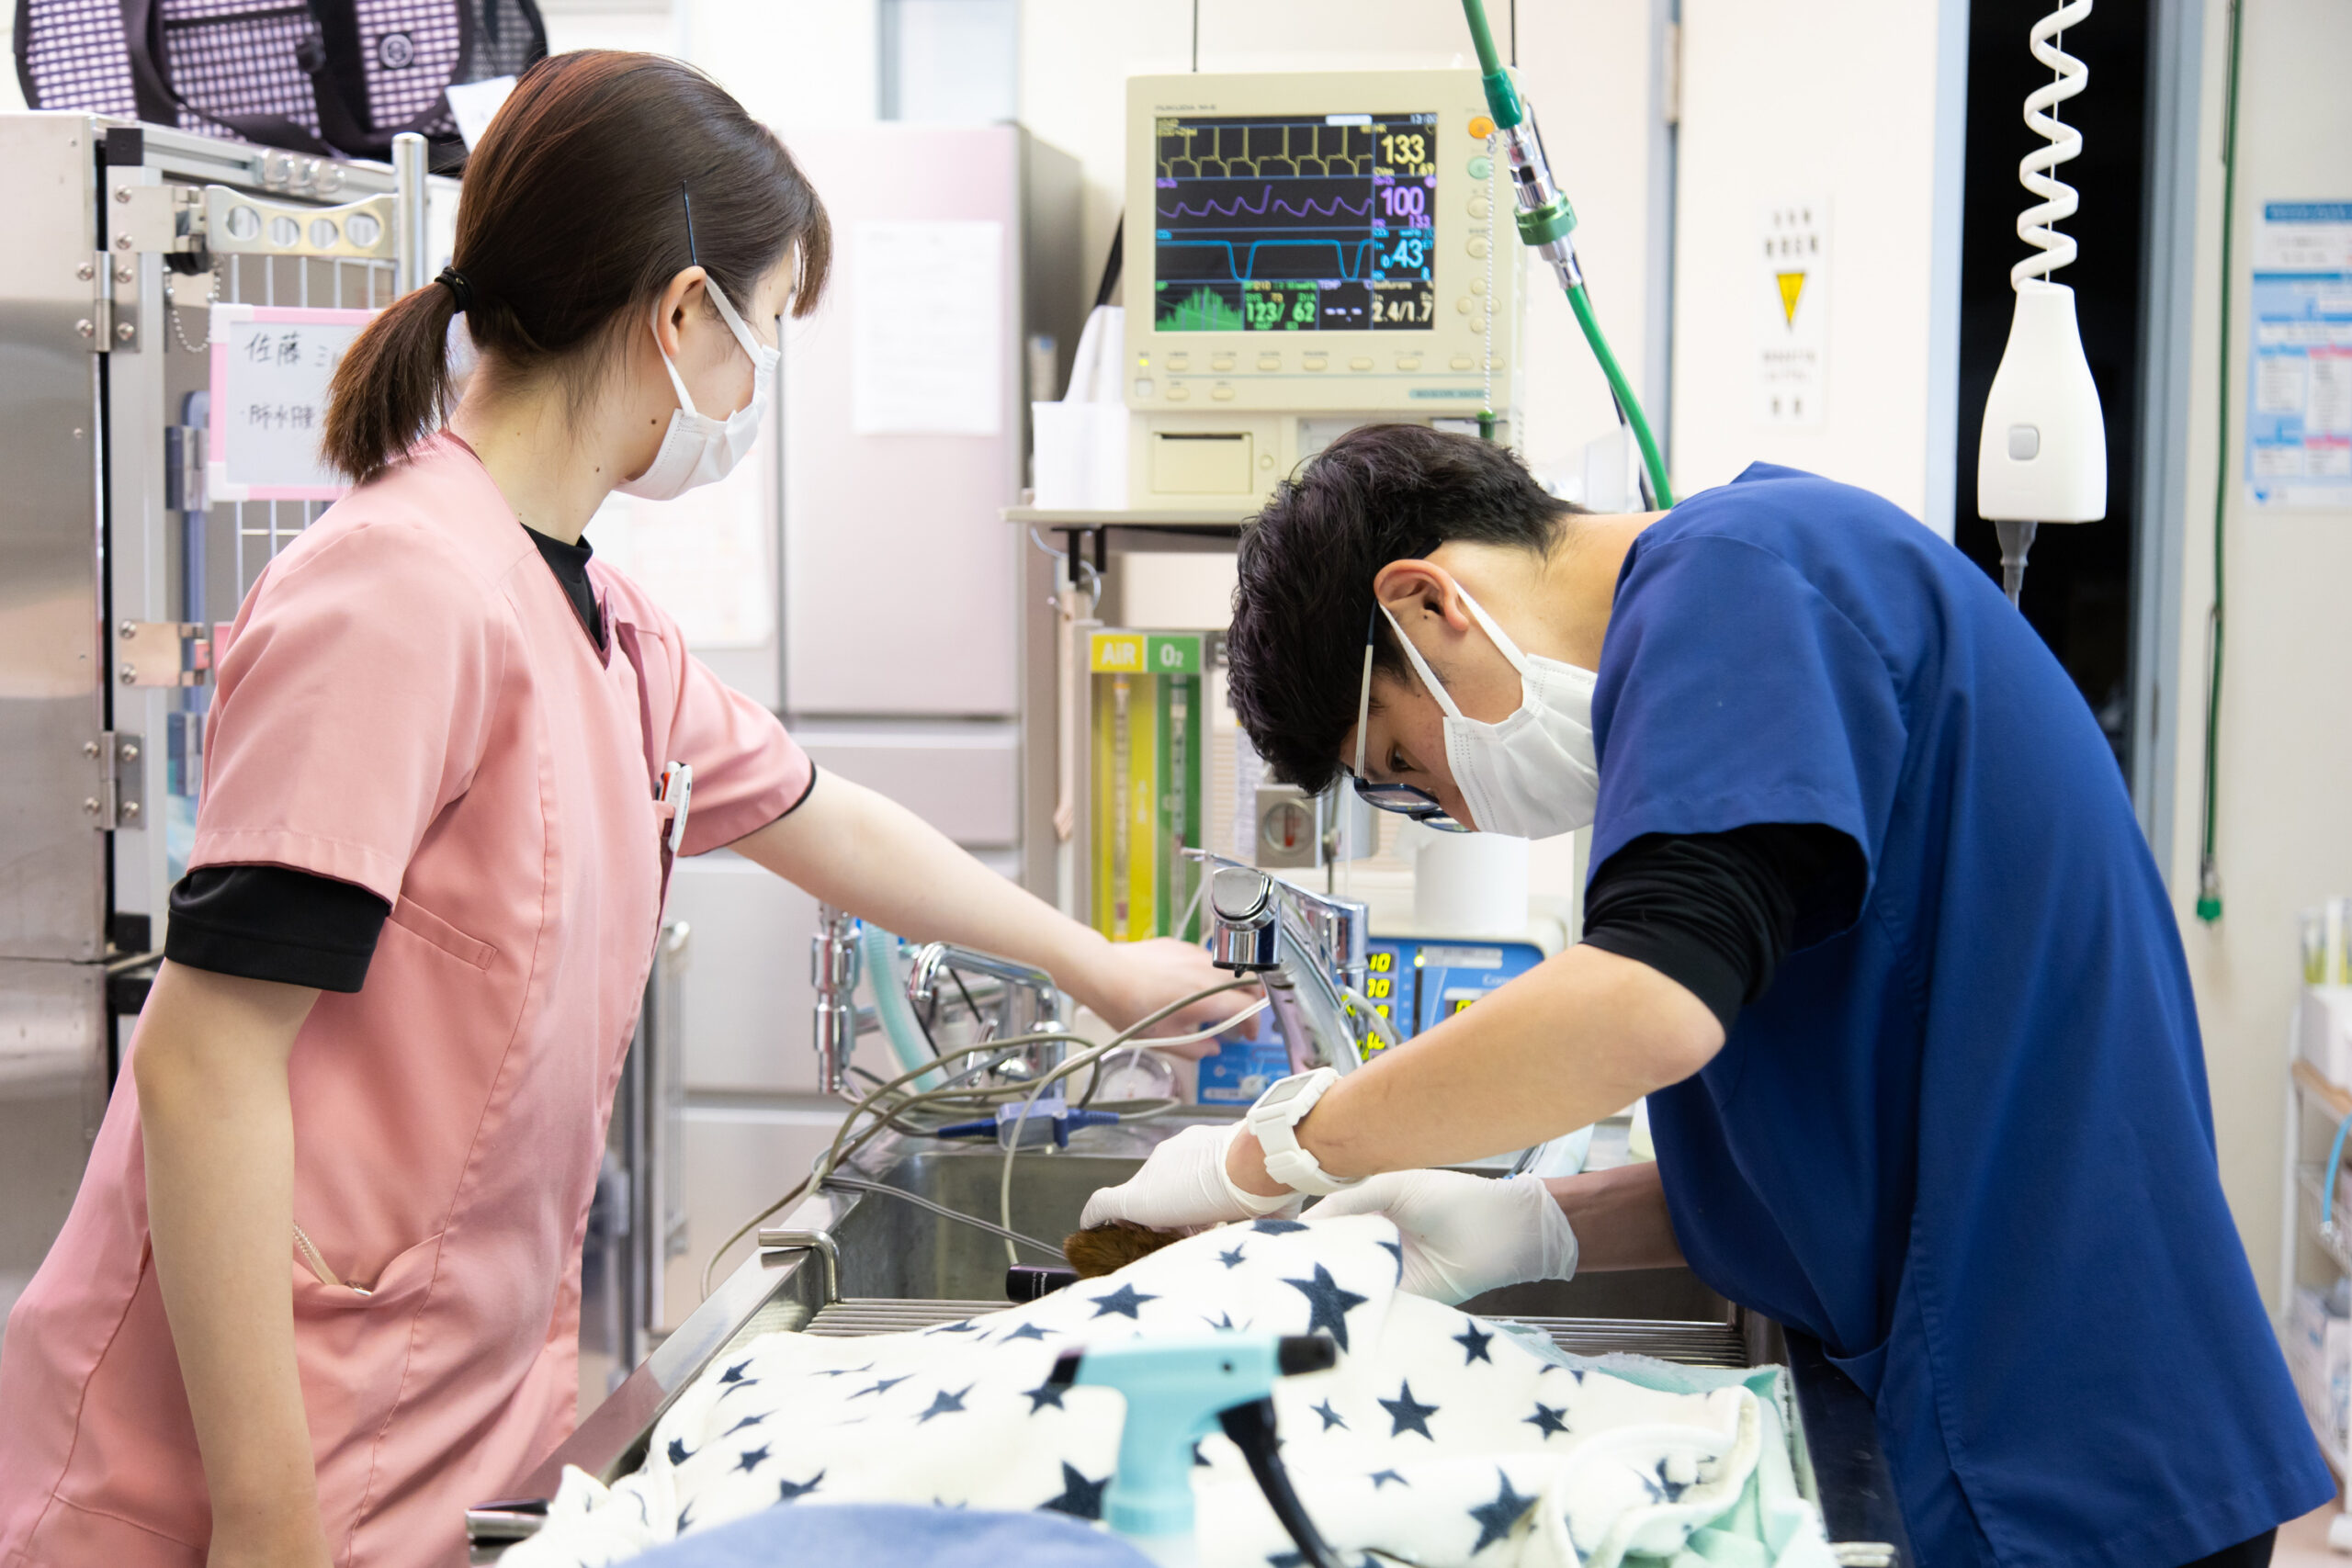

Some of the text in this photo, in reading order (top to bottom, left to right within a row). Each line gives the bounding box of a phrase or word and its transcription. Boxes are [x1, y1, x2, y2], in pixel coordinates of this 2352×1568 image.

[1381, 134, 1426, 164] 133
[1380, 186, 1425, 217] 100
[1292, 301, 1316, 322] 62
[1159, 643, 1183, 667] O2
